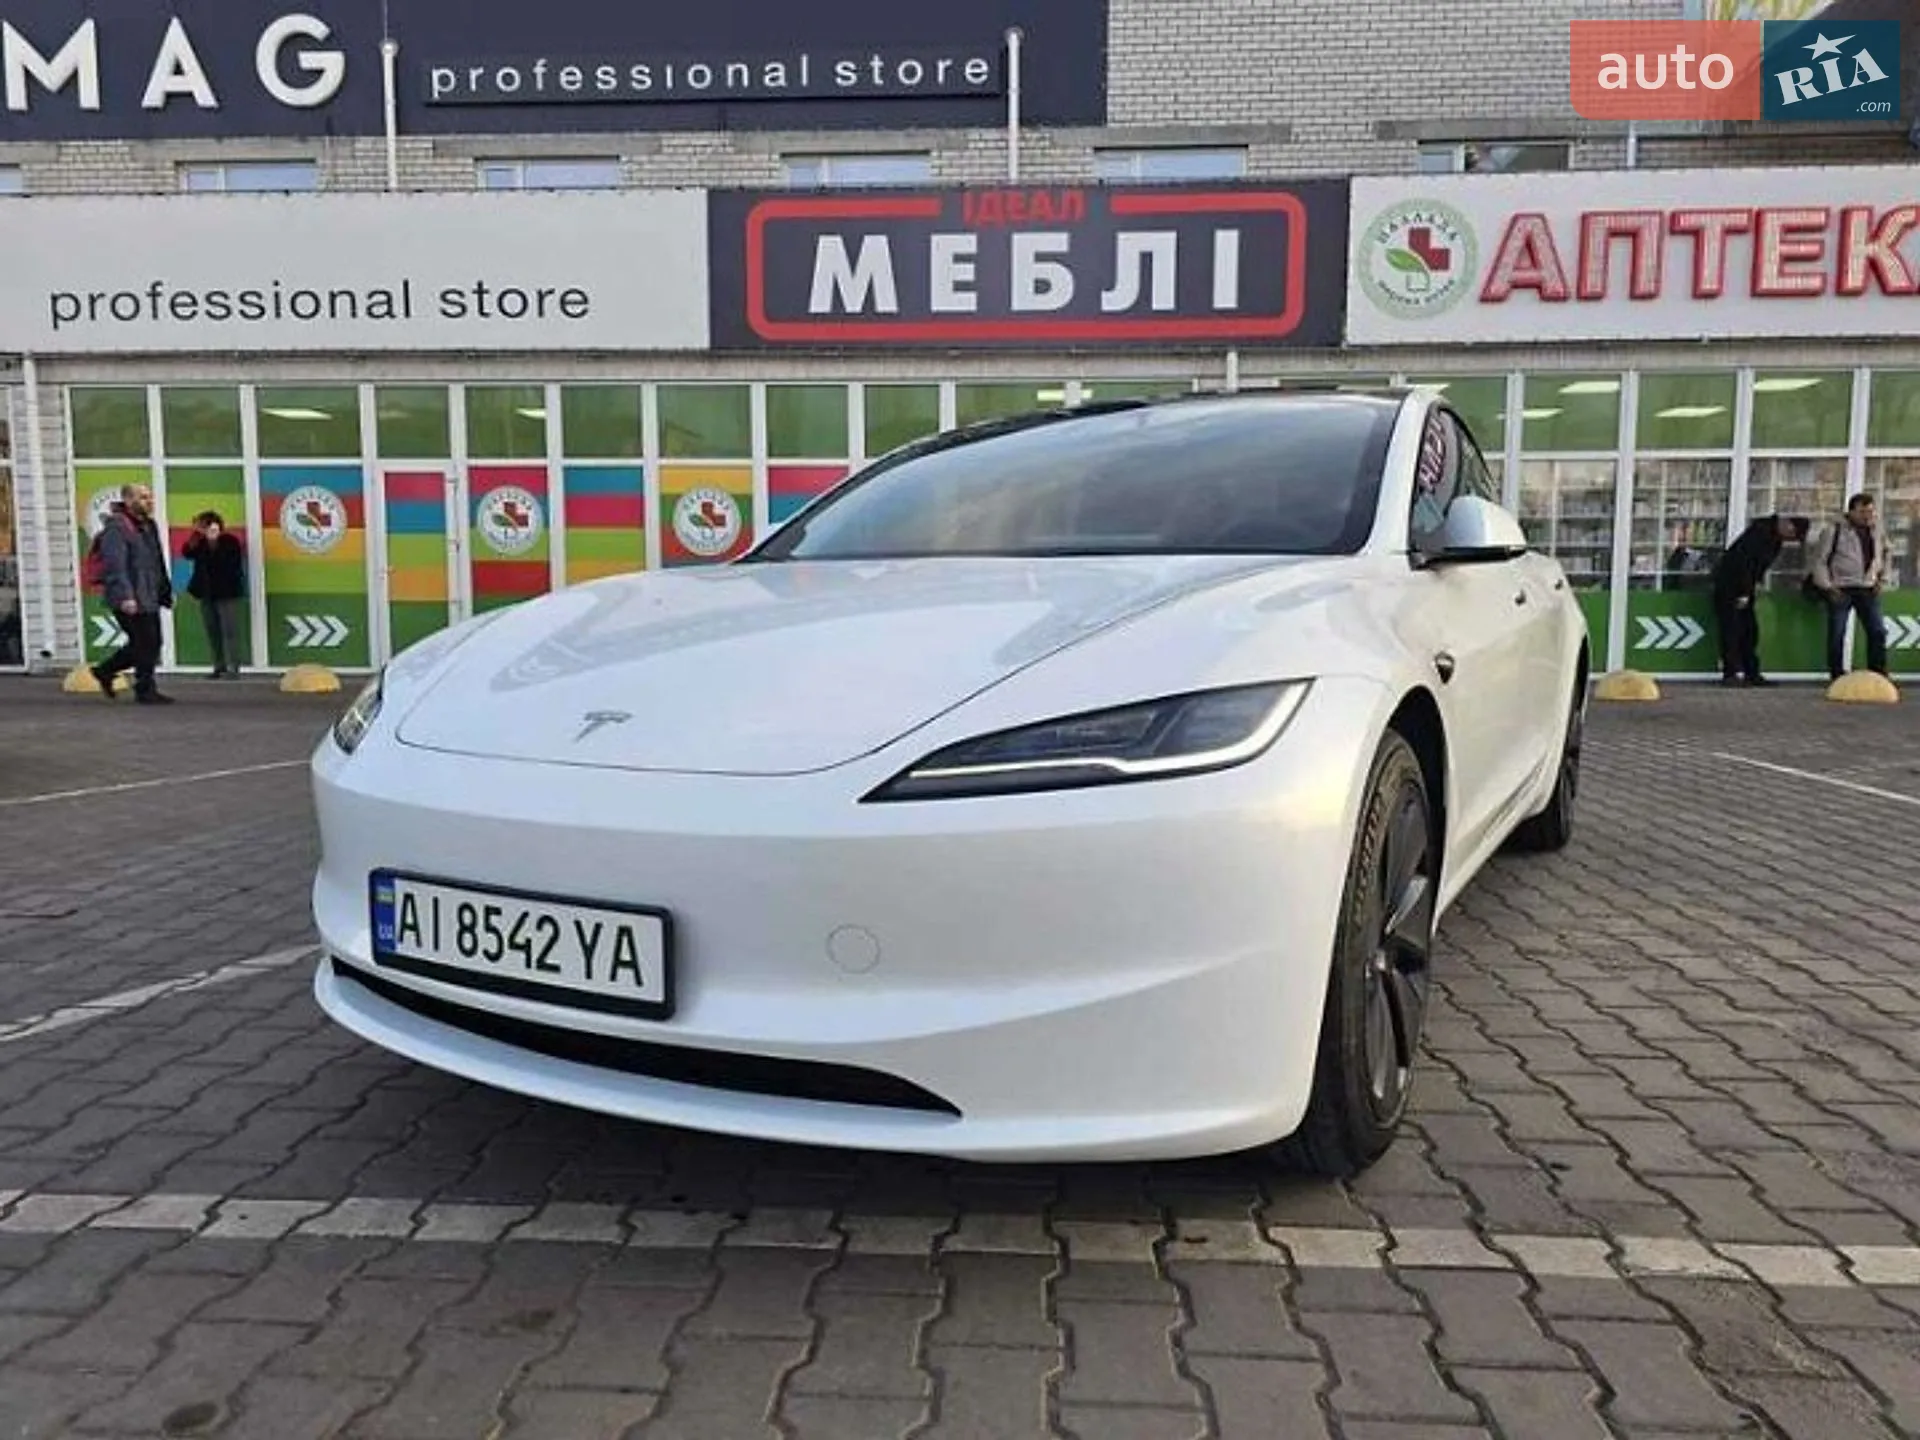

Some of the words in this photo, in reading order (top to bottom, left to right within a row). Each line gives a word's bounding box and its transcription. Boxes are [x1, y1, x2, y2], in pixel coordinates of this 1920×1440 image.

[2, 14, 346, 111] MAG
[431, 53, 809, 100] professional
[834, 53, 990, 87] store
[962, 189, 1087, 229] ІДЕАЛ
[807, 229, 1240, 315] МЕБЛІ
[1479, 203, 1920, 304] АПТЕК
[50, 279, 411, 331] professional
[438, 279, 591, 320] store
[398, 892, 440, 952] AI
[455, 902, 562, 974] 8542
[573, 919, 645, 988] YA
